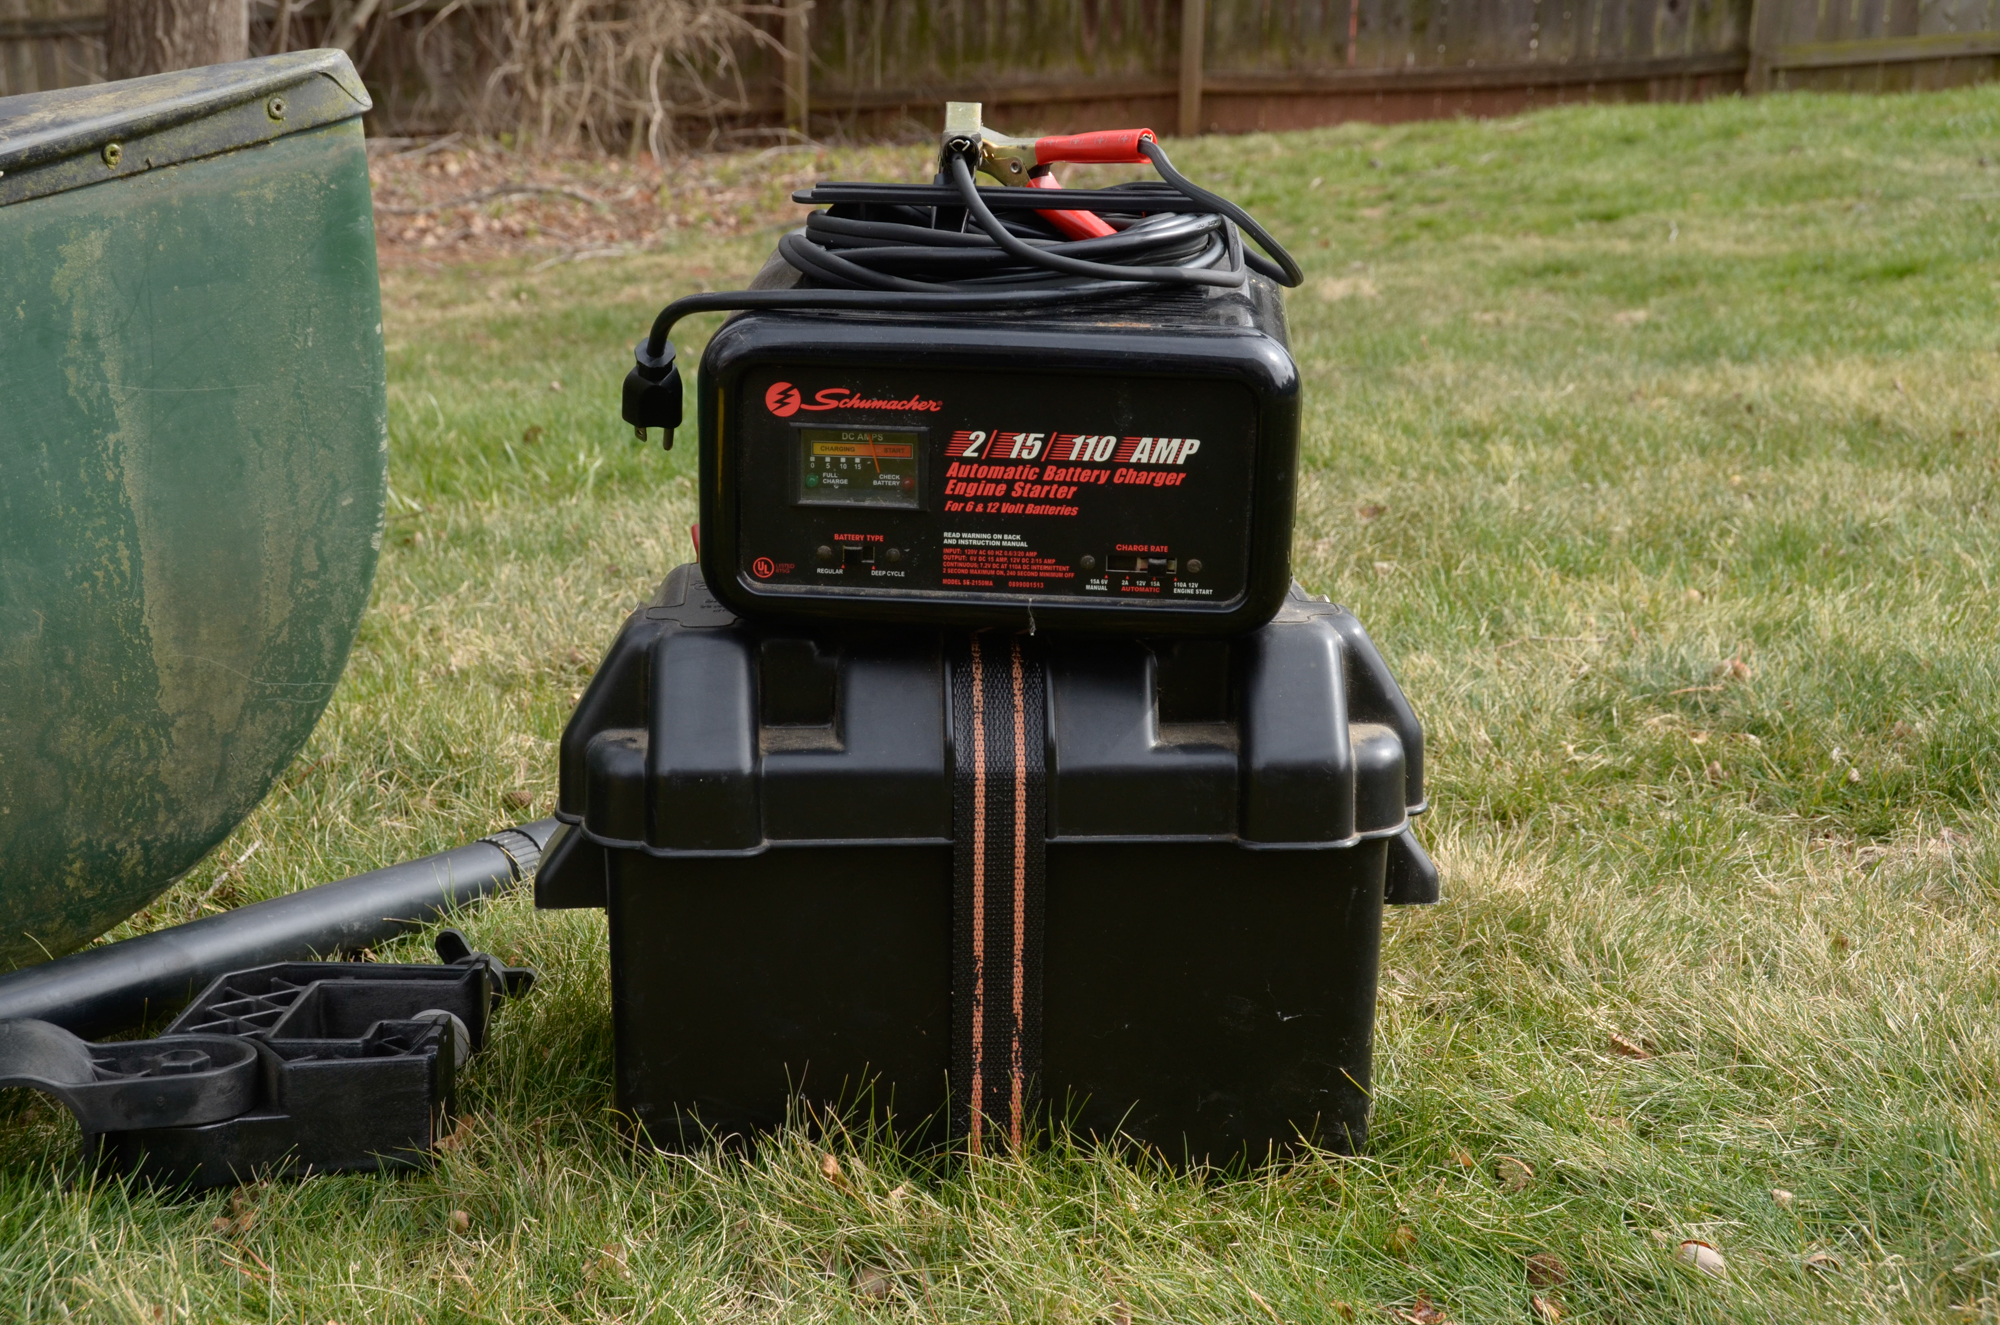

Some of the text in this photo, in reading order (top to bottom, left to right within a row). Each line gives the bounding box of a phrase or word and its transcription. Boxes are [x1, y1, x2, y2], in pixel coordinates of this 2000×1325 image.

[842, 432, 855, 440] DC
[820, 445, 856, 453] CHARGING
[1129, 437, 1201, 465] AMP
[945, 462, 1187, 487] Automatic Battery Charger
[944, 479, 1079, 499] Engine Starter
[944, 500, 1080, 516] For 6 & 12 Volt Batteries
[834, 533, 884, 542] BATTERY TYPE
[1115, 543, 1169, 553] CHARGE RATE
[816, 567, 844, 575] REGULAR
[871, 569, 886, 577] DEEP
